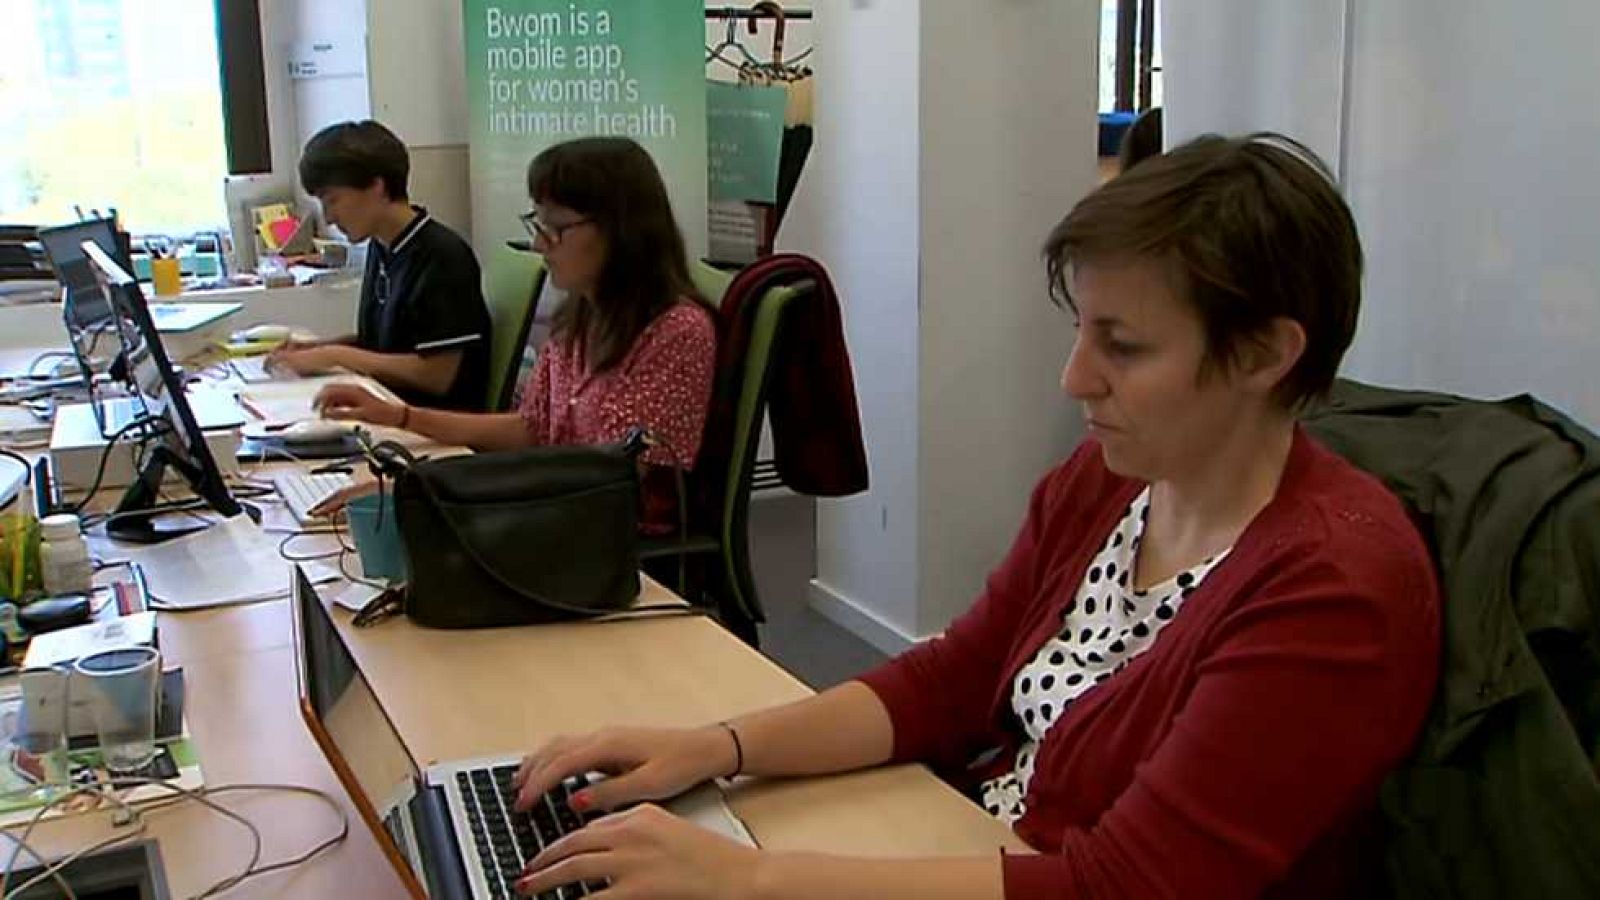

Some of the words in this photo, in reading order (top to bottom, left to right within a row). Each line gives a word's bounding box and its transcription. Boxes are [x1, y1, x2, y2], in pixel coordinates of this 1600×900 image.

[487, 7, 561, 38] Bwom
[569, 3, 589, 36] is
[596, 9, 611, 35] a
[487, 39, 567, 70] mobile
[575, 43, 622, 76] app
[488, 72, 522, 102] for
[528, 68, 640, 103] women's
[488, 104, 589, 135] intimate
[594, 104, 677, 137] health
